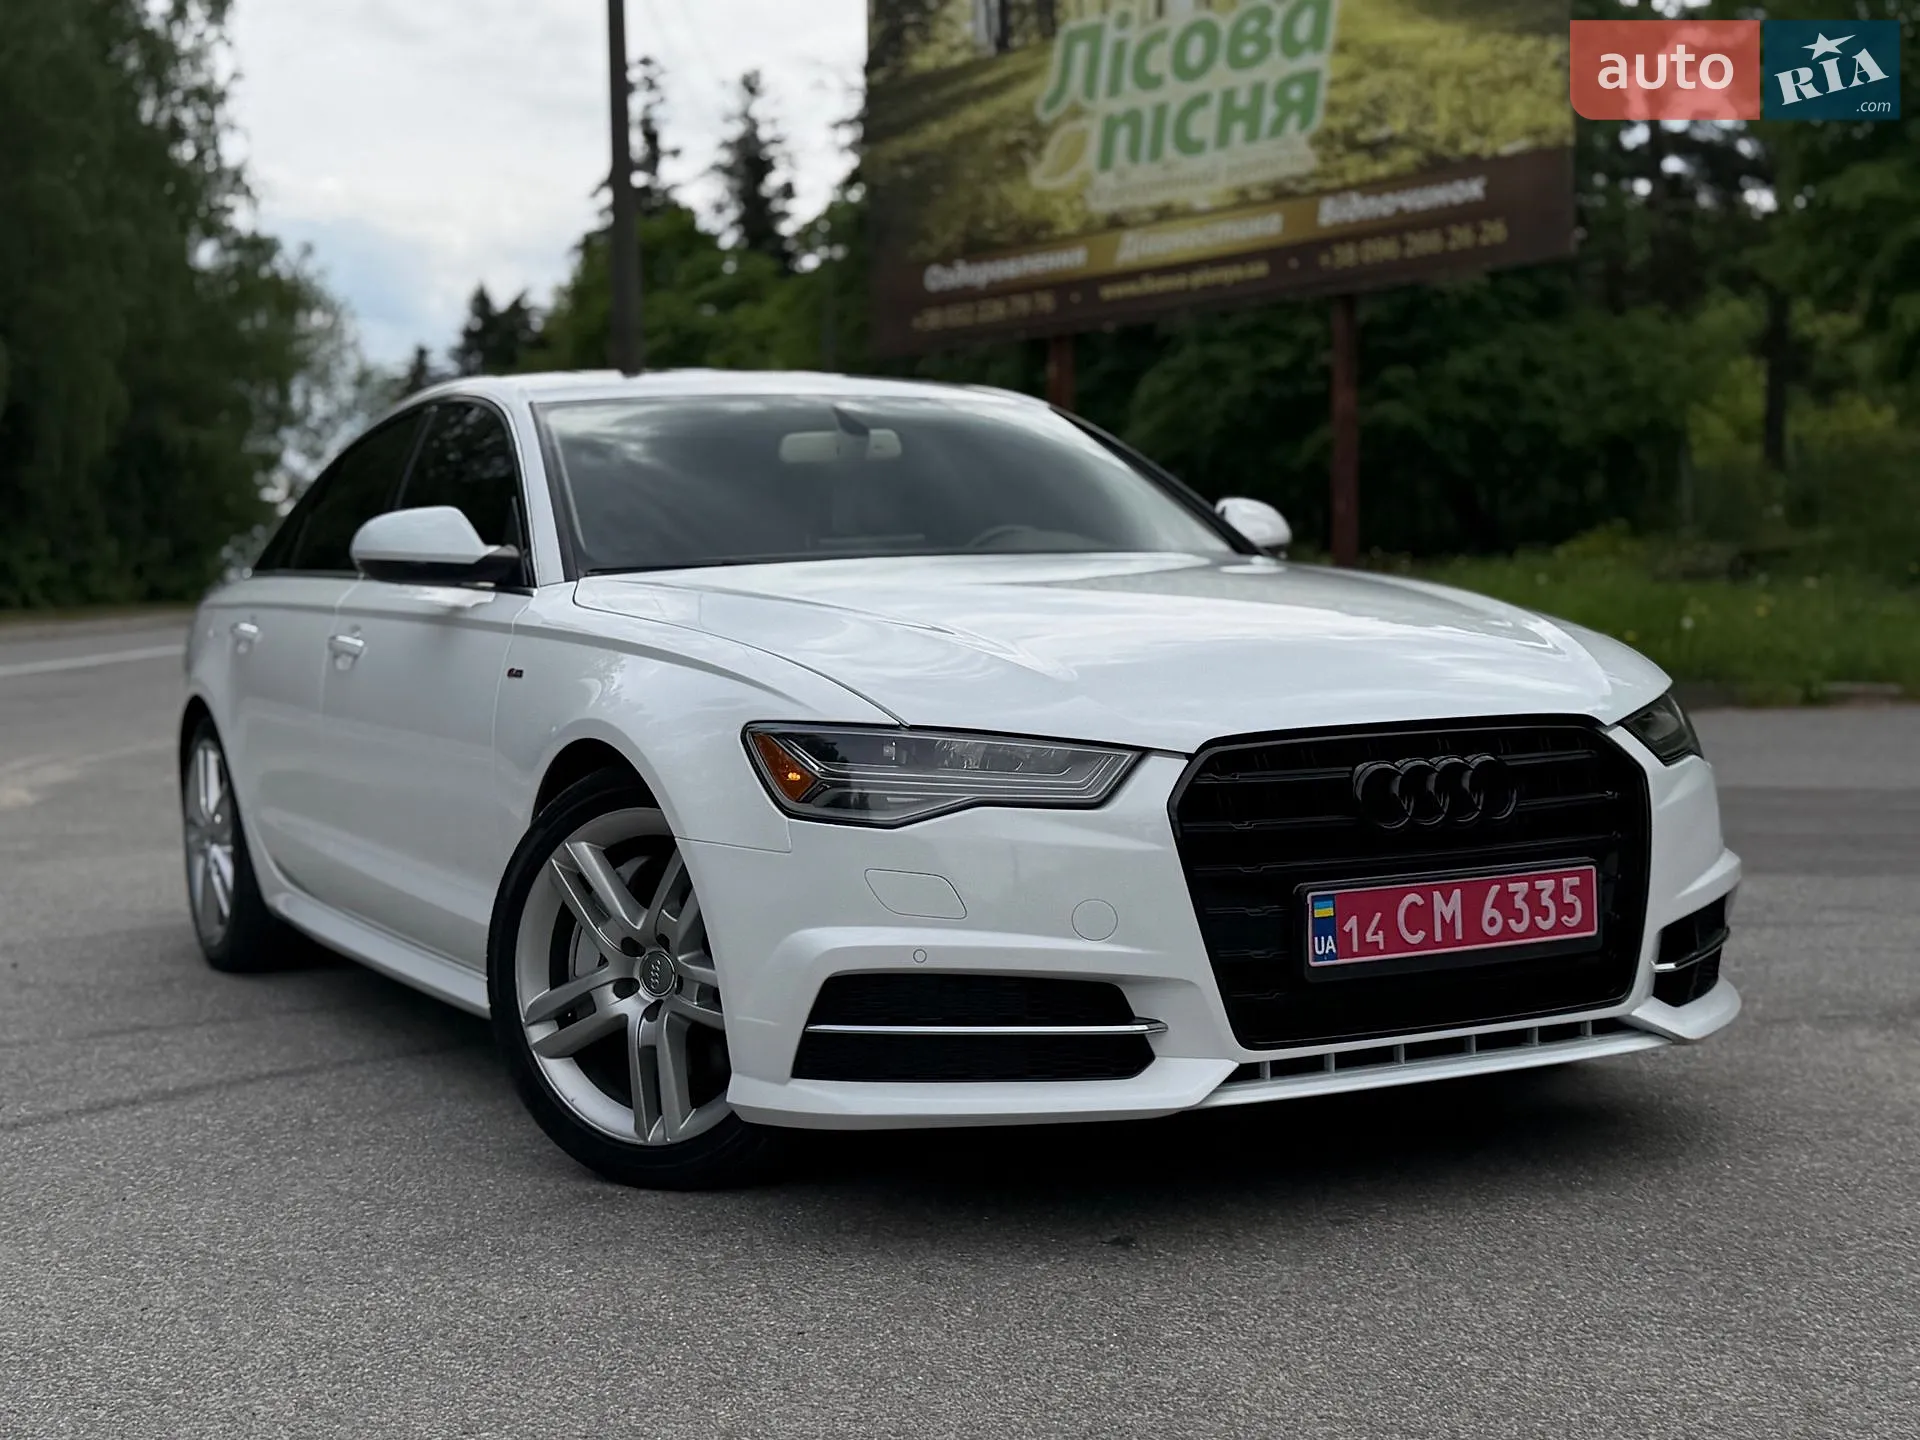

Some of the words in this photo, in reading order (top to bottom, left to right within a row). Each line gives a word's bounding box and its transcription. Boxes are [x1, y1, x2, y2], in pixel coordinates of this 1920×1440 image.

[1342, 911, 1385, 953] 14
[1396, 888, 1464, 945] CM
[1480, 875, 1584, 938] 6335
[1314, 935, 1337, 956] UA
